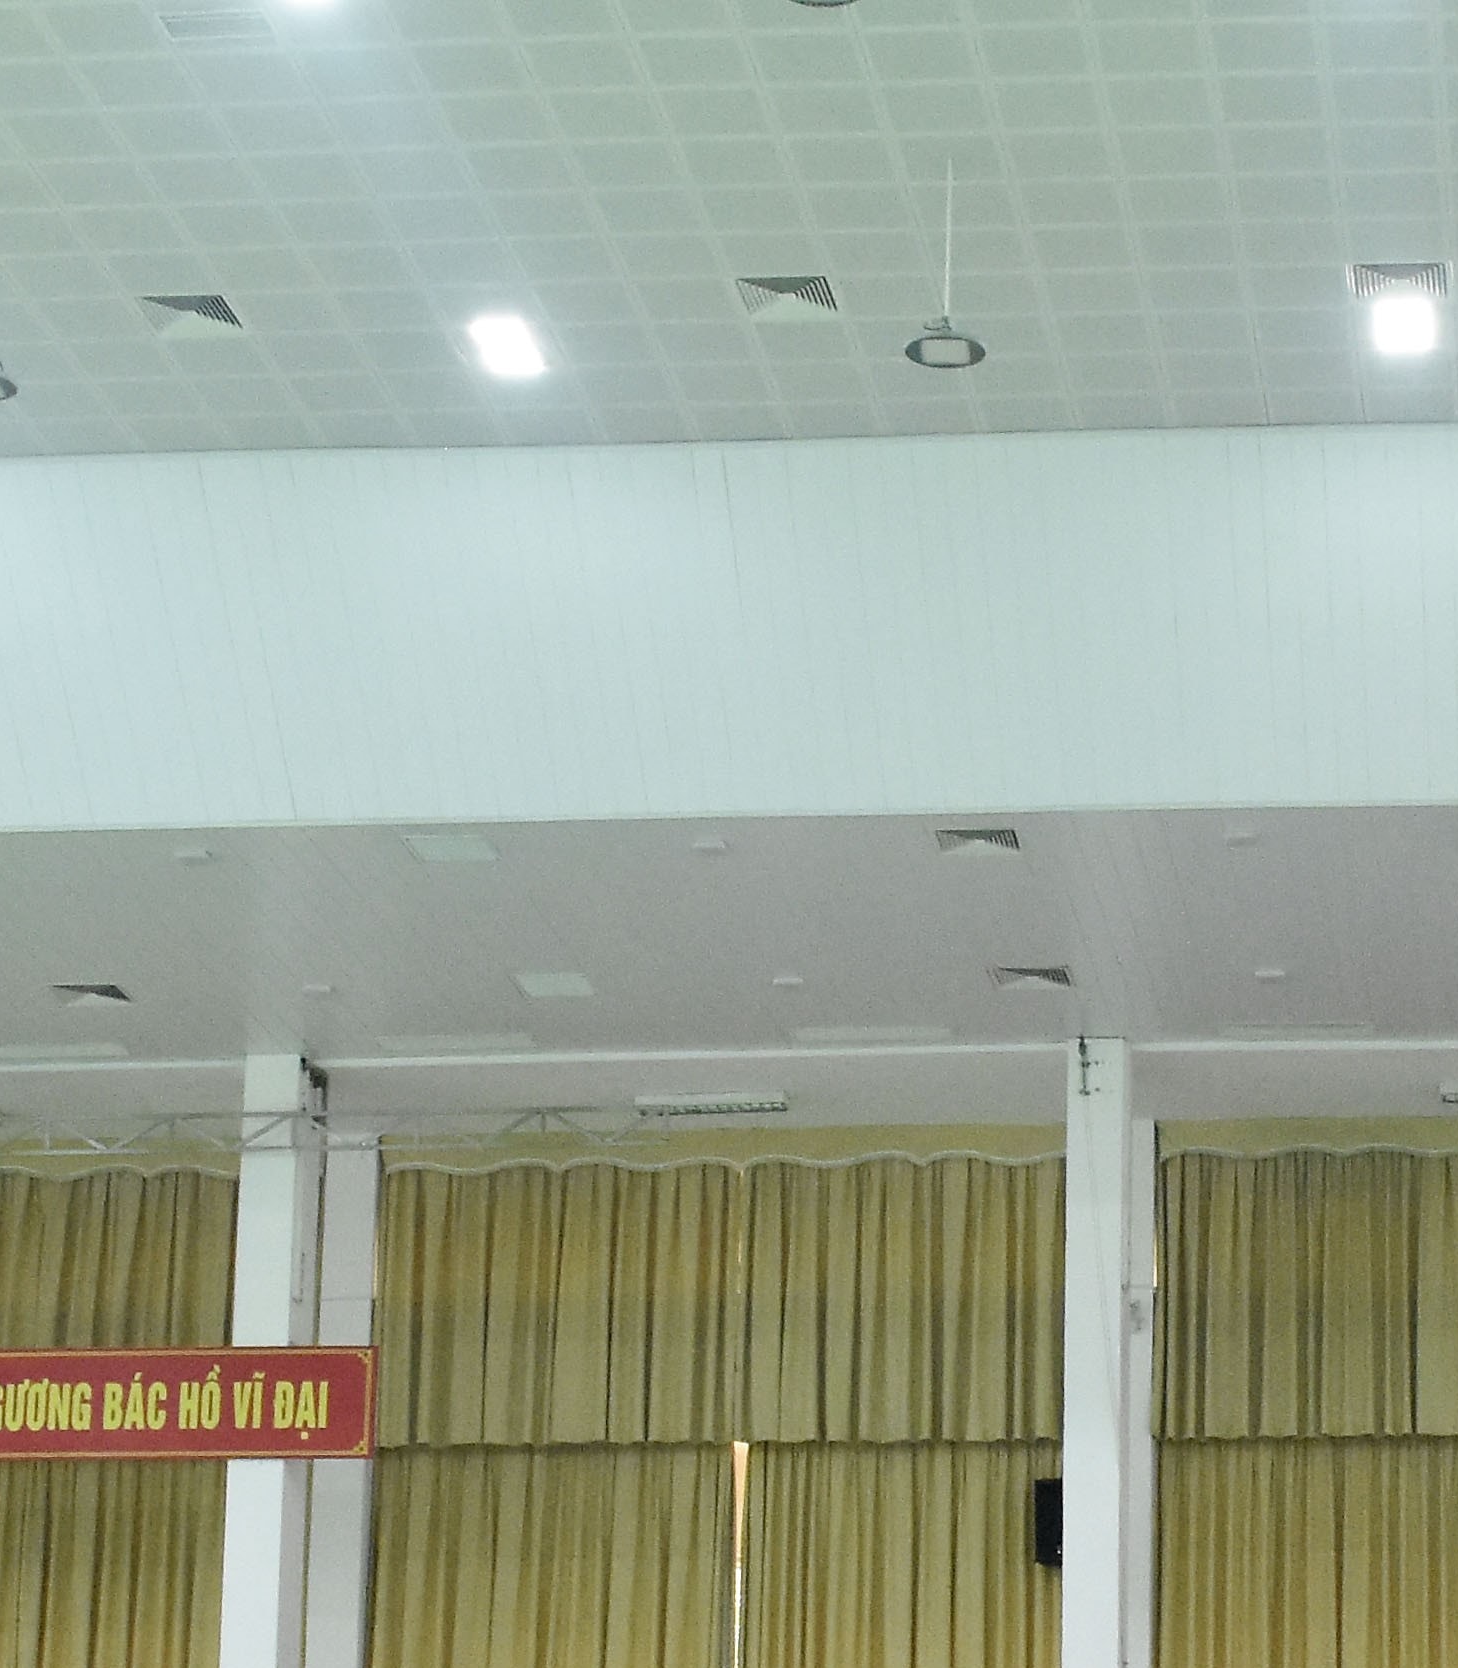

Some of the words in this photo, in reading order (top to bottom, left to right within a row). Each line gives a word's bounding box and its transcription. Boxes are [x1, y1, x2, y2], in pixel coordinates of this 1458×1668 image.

[103, 1372, 167, 1430] BÁC
[178, 1366, 221, 1429] HỒ
[234, 1372, 265, 1429] VĨ
[273, 1381, 328, 1440] ĐẠI
